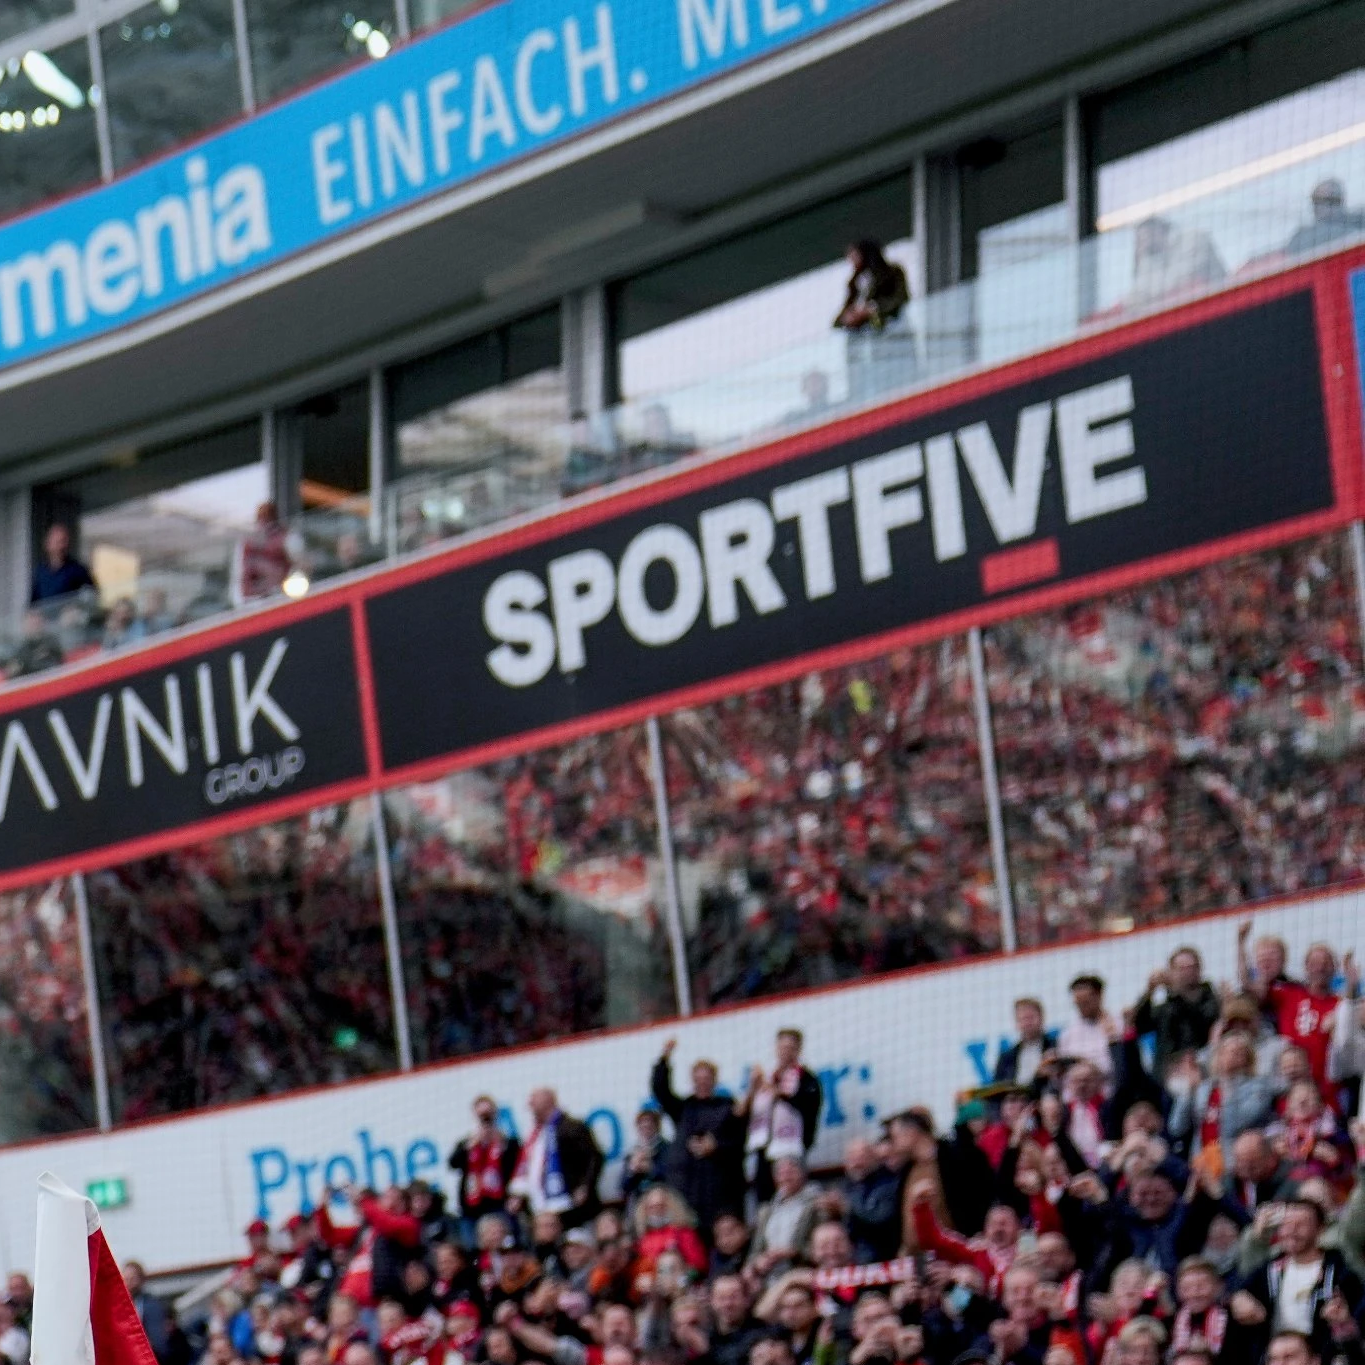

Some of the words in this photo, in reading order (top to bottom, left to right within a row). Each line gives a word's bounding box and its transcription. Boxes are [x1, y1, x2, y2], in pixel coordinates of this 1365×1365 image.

[311, 27, 649, 226] EINFACH.
[482, 374, 1147, 688] SPORTFIVE
[205, 746, 306, 804] GROUP
